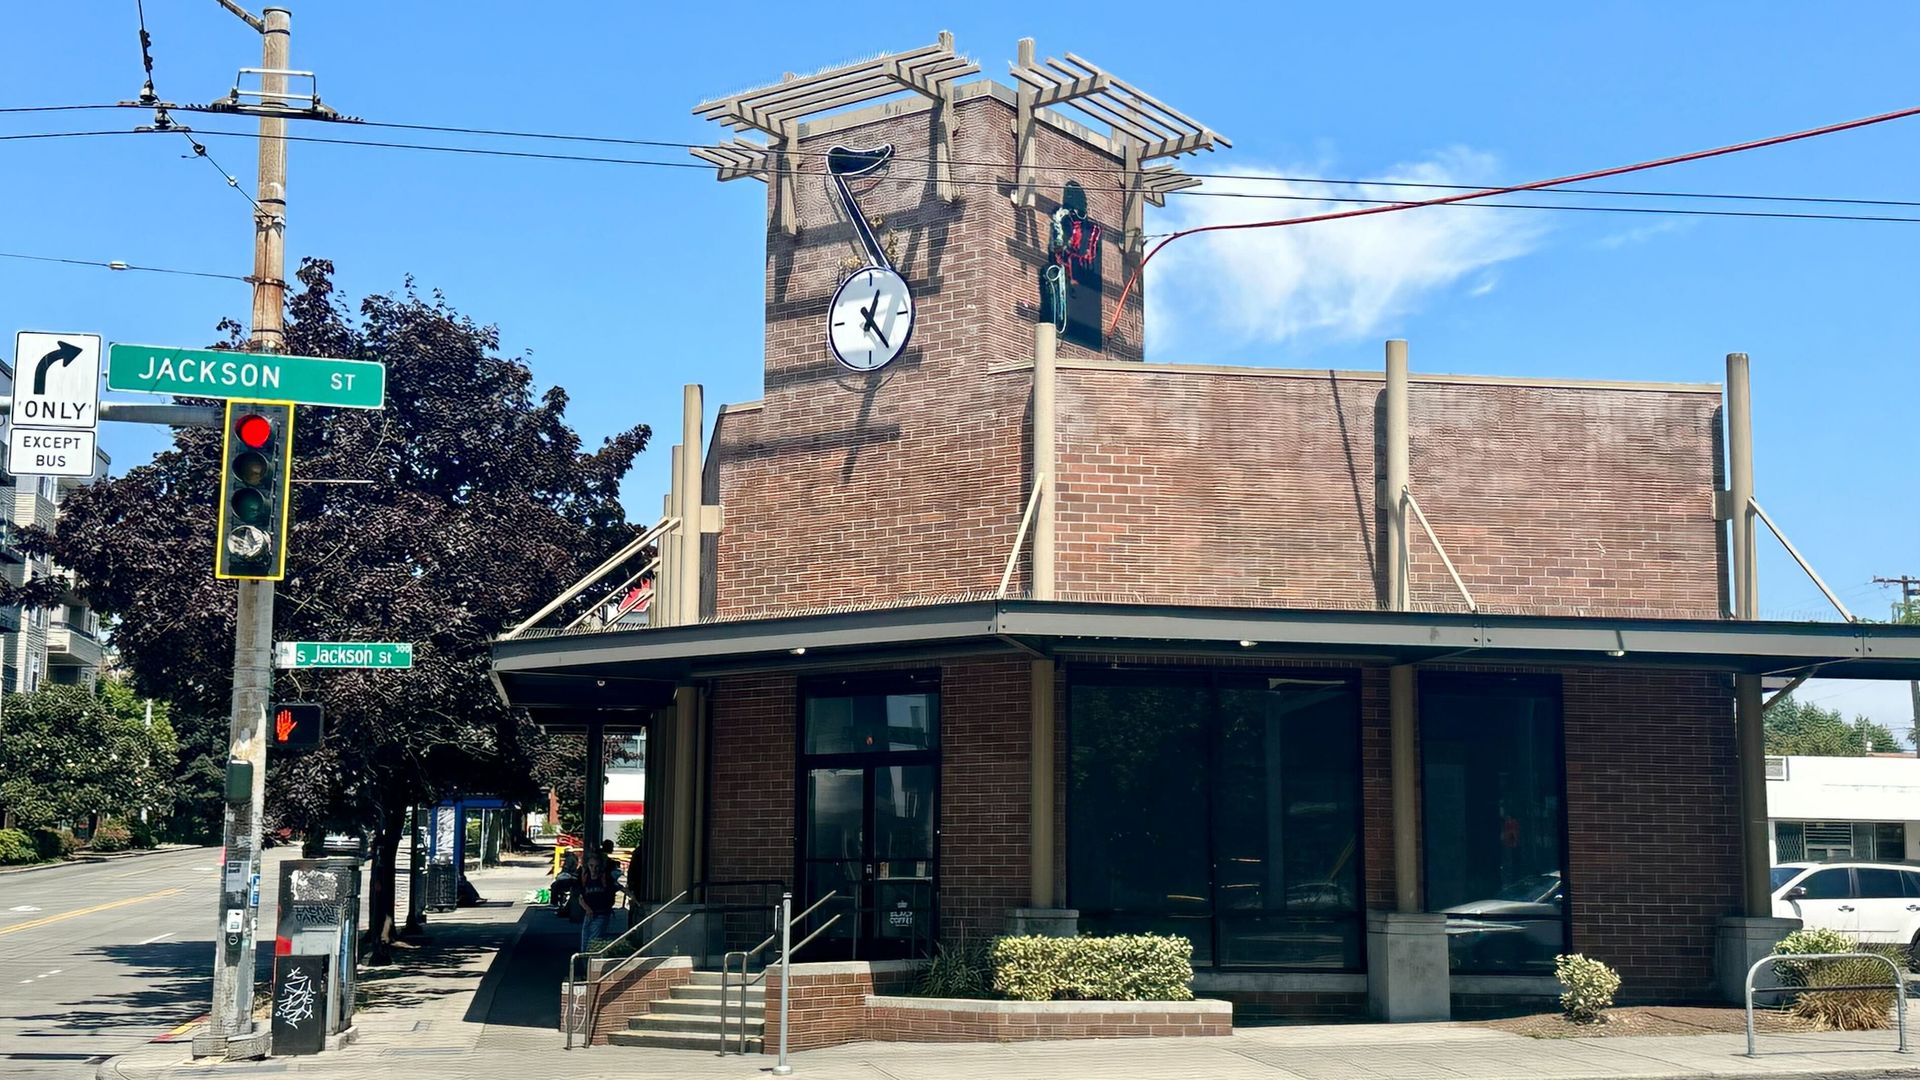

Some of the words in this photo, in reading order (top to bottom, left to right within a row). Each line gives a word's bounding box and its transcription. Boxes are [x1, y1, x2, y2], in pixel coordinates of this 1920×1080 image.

[138, 356, 281, 389] JACKSON
[330, 372, 356, 391] ST
[25, 400, 87, 420] ONLY
[23, 435, 81, 449] EXCEPT
[36, 454, 66, 467] BUS
[311, 645, 373, 664] Jackson
